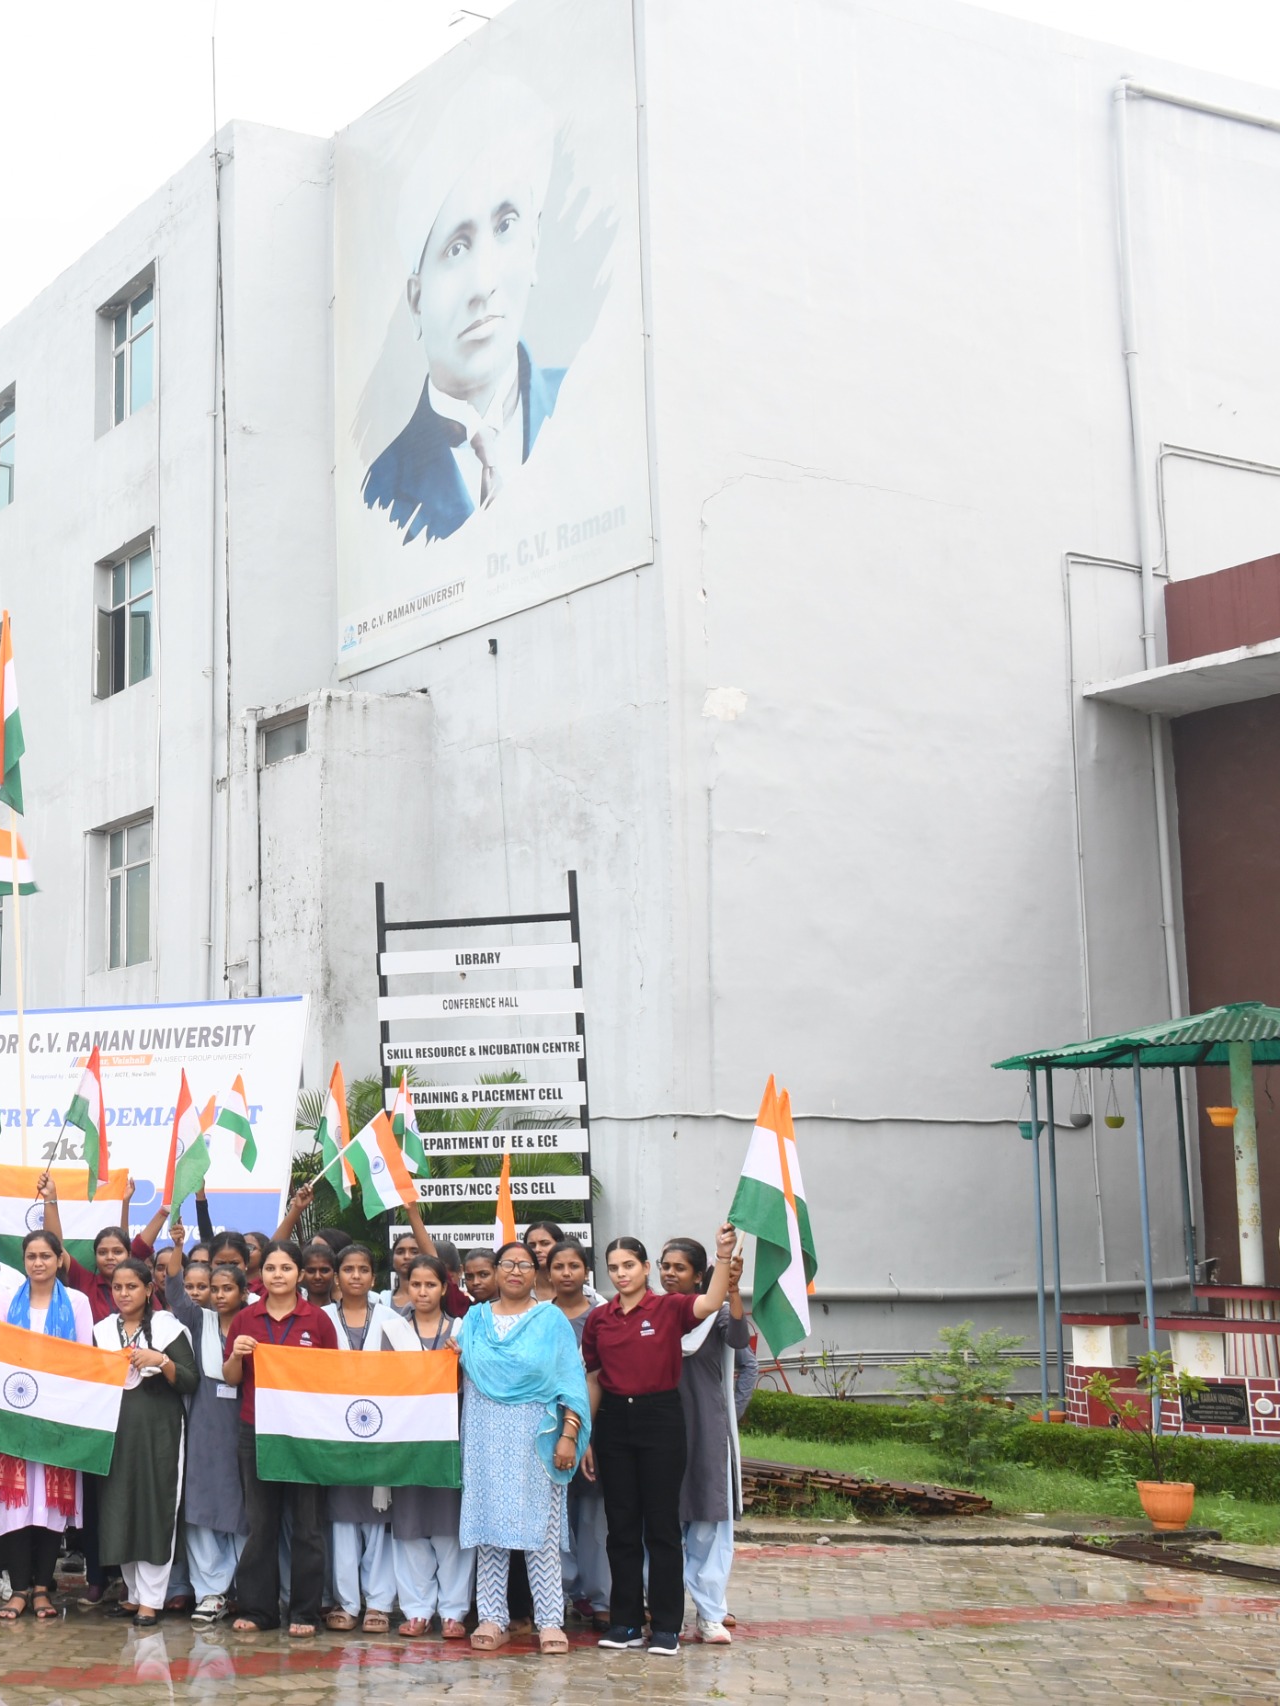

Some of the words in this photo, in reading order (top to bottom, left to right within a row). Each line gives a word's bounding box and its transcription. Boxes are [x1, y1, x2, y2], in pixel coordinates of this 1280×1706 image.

[487, 552, 510, 579] Dr.
[517, 532, 549, 566] C.V.
[557, 505, 626, 551] Raman
[357, 621, 370, 635] DR.
[372, 614, 385, 630] C.V.
[387, 601, 415, 623] RAMAN
[417, 580, 466, 611] UNIVERSITY
[455, 952, 501, 966] LIBRARY
[442, 997, 496, 1010] CONFERENCE
[499, 996, 519, 1008] HALL
[28, 1032, 62, 1054] C.V.
[66, 1028, 137, 1054] RAMAN
[139, 1024, 256, 1051] UNIVERSITY
[164, 1055, 187, 1063] AISECT
[188, 1054, 212, 1062] GROUP
[213, 1053, 252, 1061] UNIVERSITY
[387, 1048, 413, 1060] SKILL
[415, 1045, 467, 1059] RESOURCE
[469, 1046, 476, 1056] &
[478, 1043, 540, 1056] INCUBATION
[542, 1041, 580, 1054] CENTRE
[461, 1092, 469, 1103] &
[472, 1088, 535, 1102] PLACEMENT
[538, 1088, 563, 1100] CELL
[422, 1137, 489, 1151] EPARTMENT
[492, 1136, 505, 1149] OF
[511, 1135, 523, 1148] EE
[526, 1137, 535, 1147] &
[537, 1135, 558, 1147] ECE
[420, 1183, 492, 1197] SPORTS/NCC
[531, 1182, 556, 1195] CELL
[442, 1233, 452, 1242] OF
[453, 1232, 495, 1242] COMPUTER
